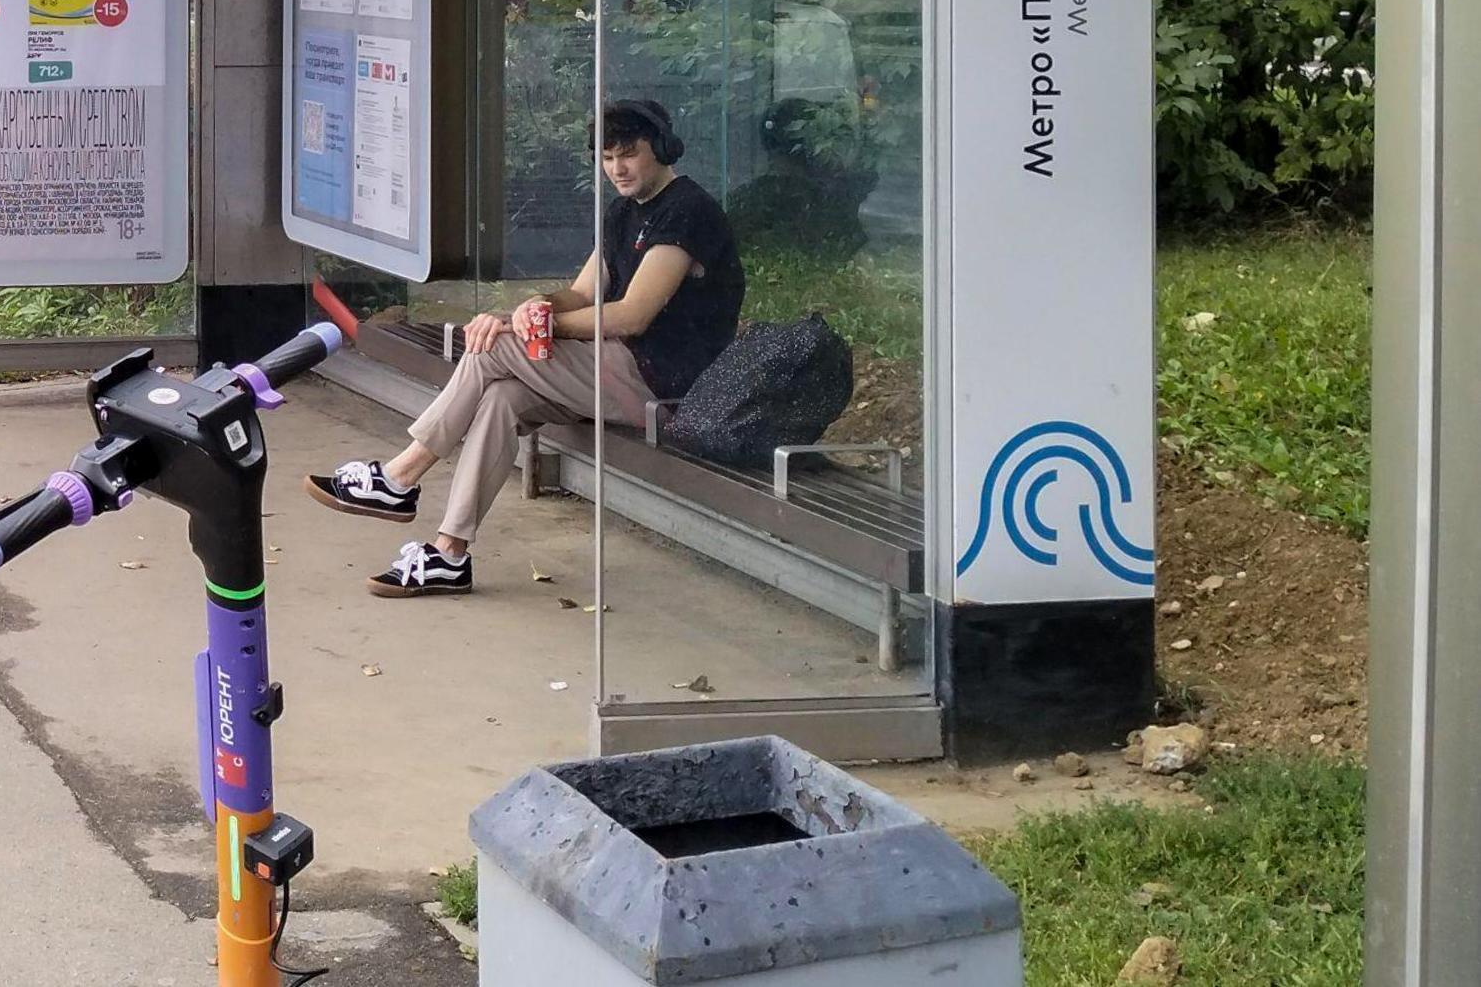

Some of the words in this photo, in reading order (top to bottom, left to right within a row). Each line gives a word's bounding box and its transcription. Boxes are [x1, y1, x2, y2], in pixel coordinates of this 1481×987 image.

[79, 88, 146, 150] СРЕДСТВОМ
[1023, 52, 1061, 177] Метро
[117, 219, 145, 240] 18+
[216, 664, 235, 745] ЮРЕНТ
